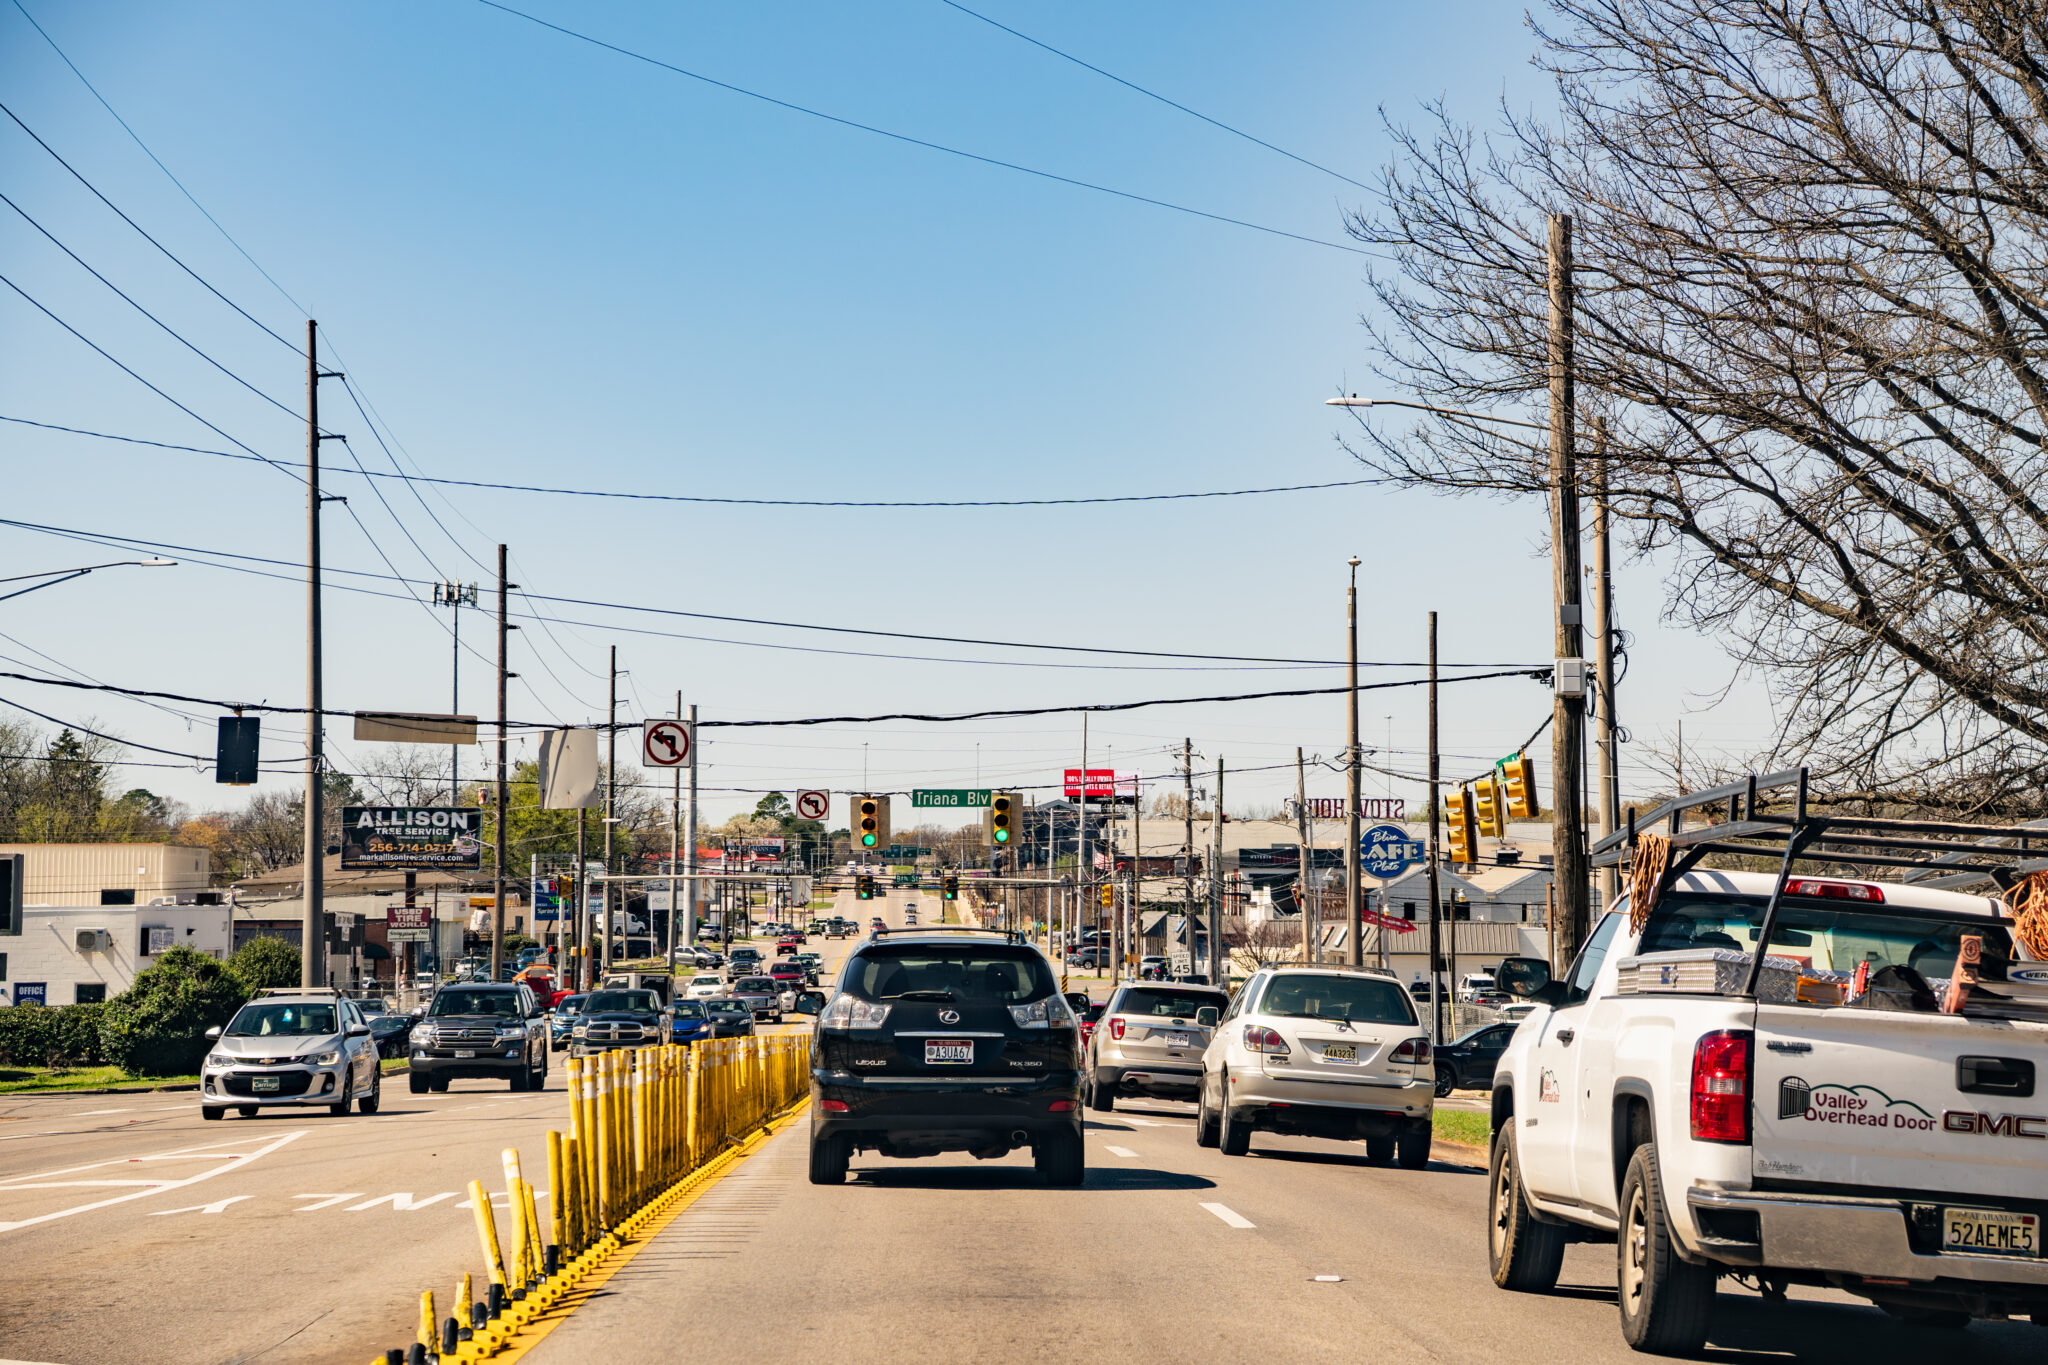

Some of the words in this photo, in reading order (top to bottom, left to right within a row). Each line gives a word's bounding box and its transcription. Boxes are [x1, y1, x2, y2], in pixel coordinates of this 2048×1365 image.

[916, 791, 958, 805] Triana
[967, 791, 989, 805] Blv
[357, 811, 468, 829] ALLISON
[375, 827, 402, 835] TREE
[405, 827, 450, 836] SERVICE
[1371, 831, 1399, 843] Blue
[369, 843, 454, 853] 256-714-0717
[1370, 860, 1400, 872] Plate
[1174, 964, 1190, 974] 45
[19, 986, 44, 995] OFFICE
[936, 1046, 970, 1059] A3UA67
[1815, 1092, 1868, 1110] Valley
[1804, 1107, 1888, 1127] Overhead
[1893, 1113, 1937, 1131] Door
[1942, 1110, 2048, 1139] GMC
[1969, 1211, 2015, 1222] ALABAMA
[1951, 1222, 2032, 1249] 52AEME5
